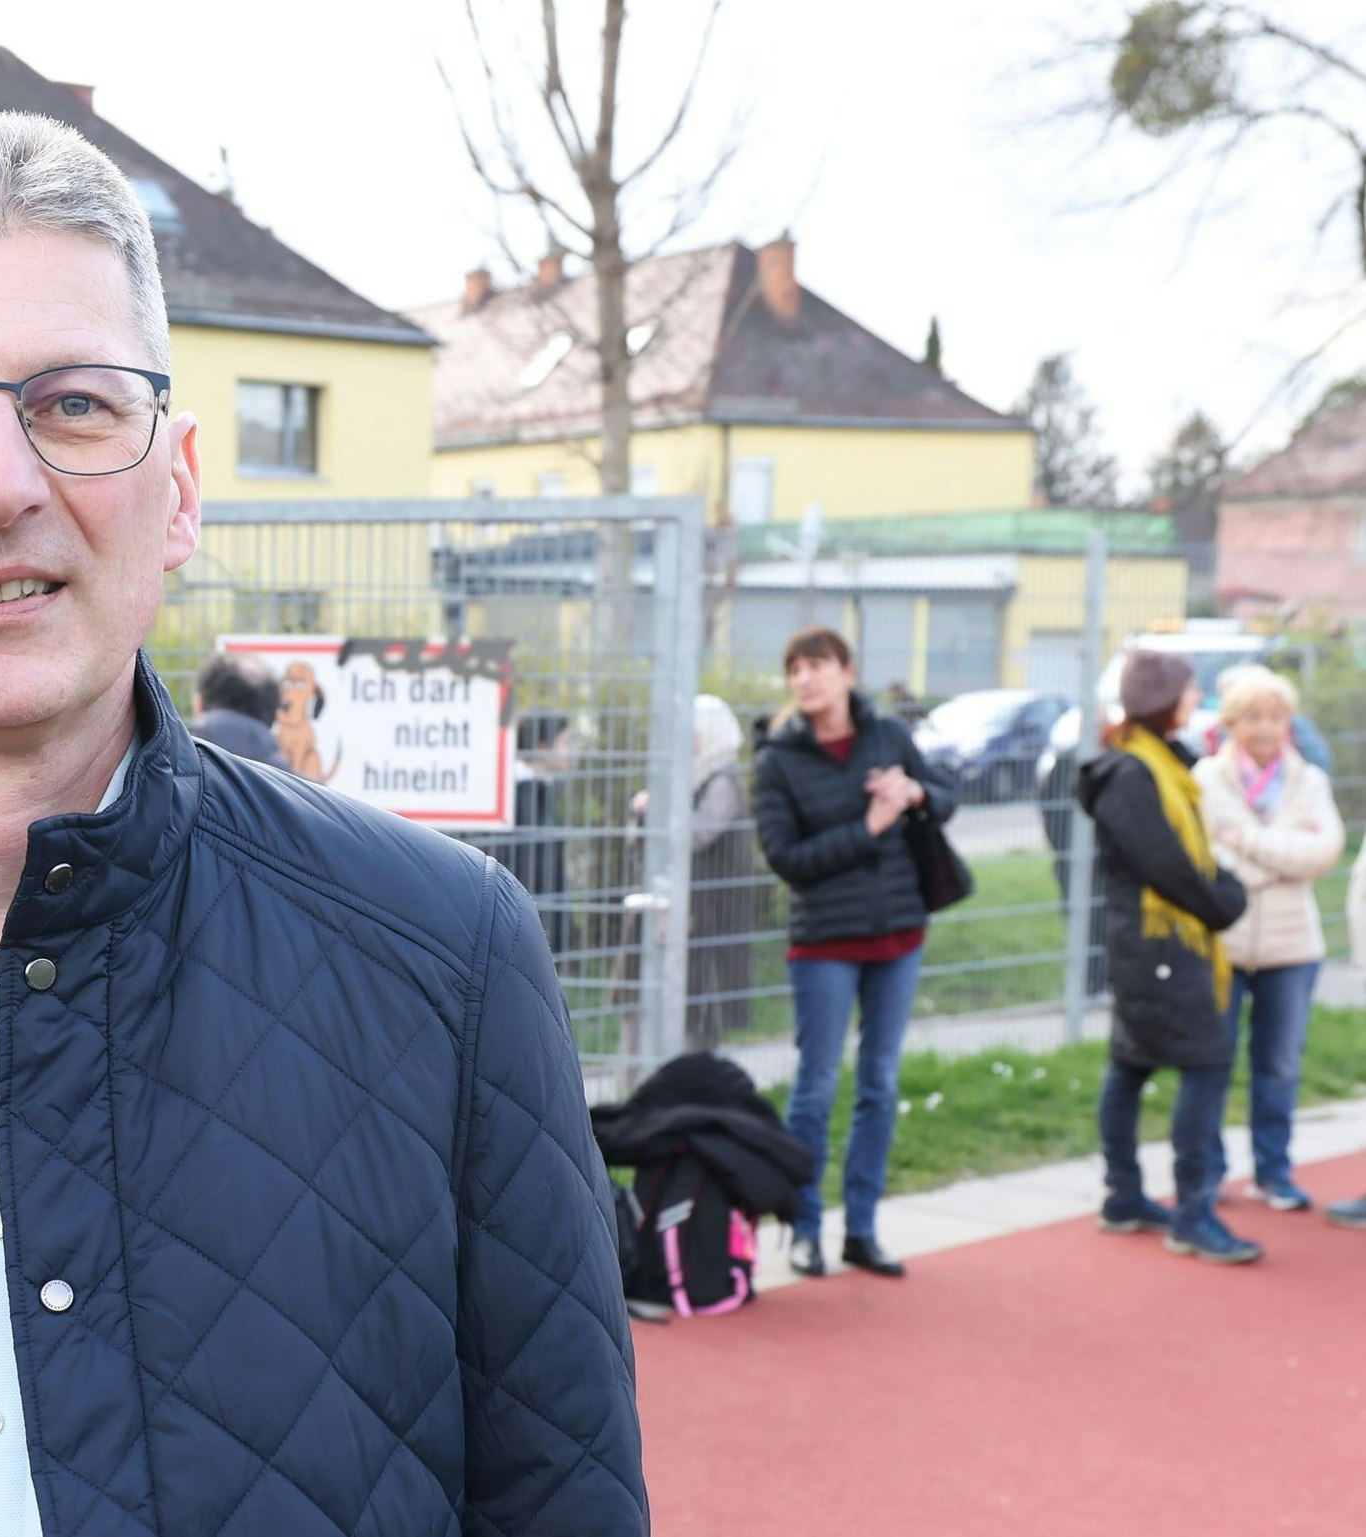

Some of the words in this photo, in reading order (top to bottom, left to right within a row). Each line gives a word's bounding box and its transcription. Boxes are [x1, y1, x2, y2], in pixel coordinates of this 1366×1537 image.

[351, 671, 396, 702] Ich
[409, 669, 471, 703] darf
[394, 716, 470, 747] nicht
[363, 760, 469, 791] hinein!
